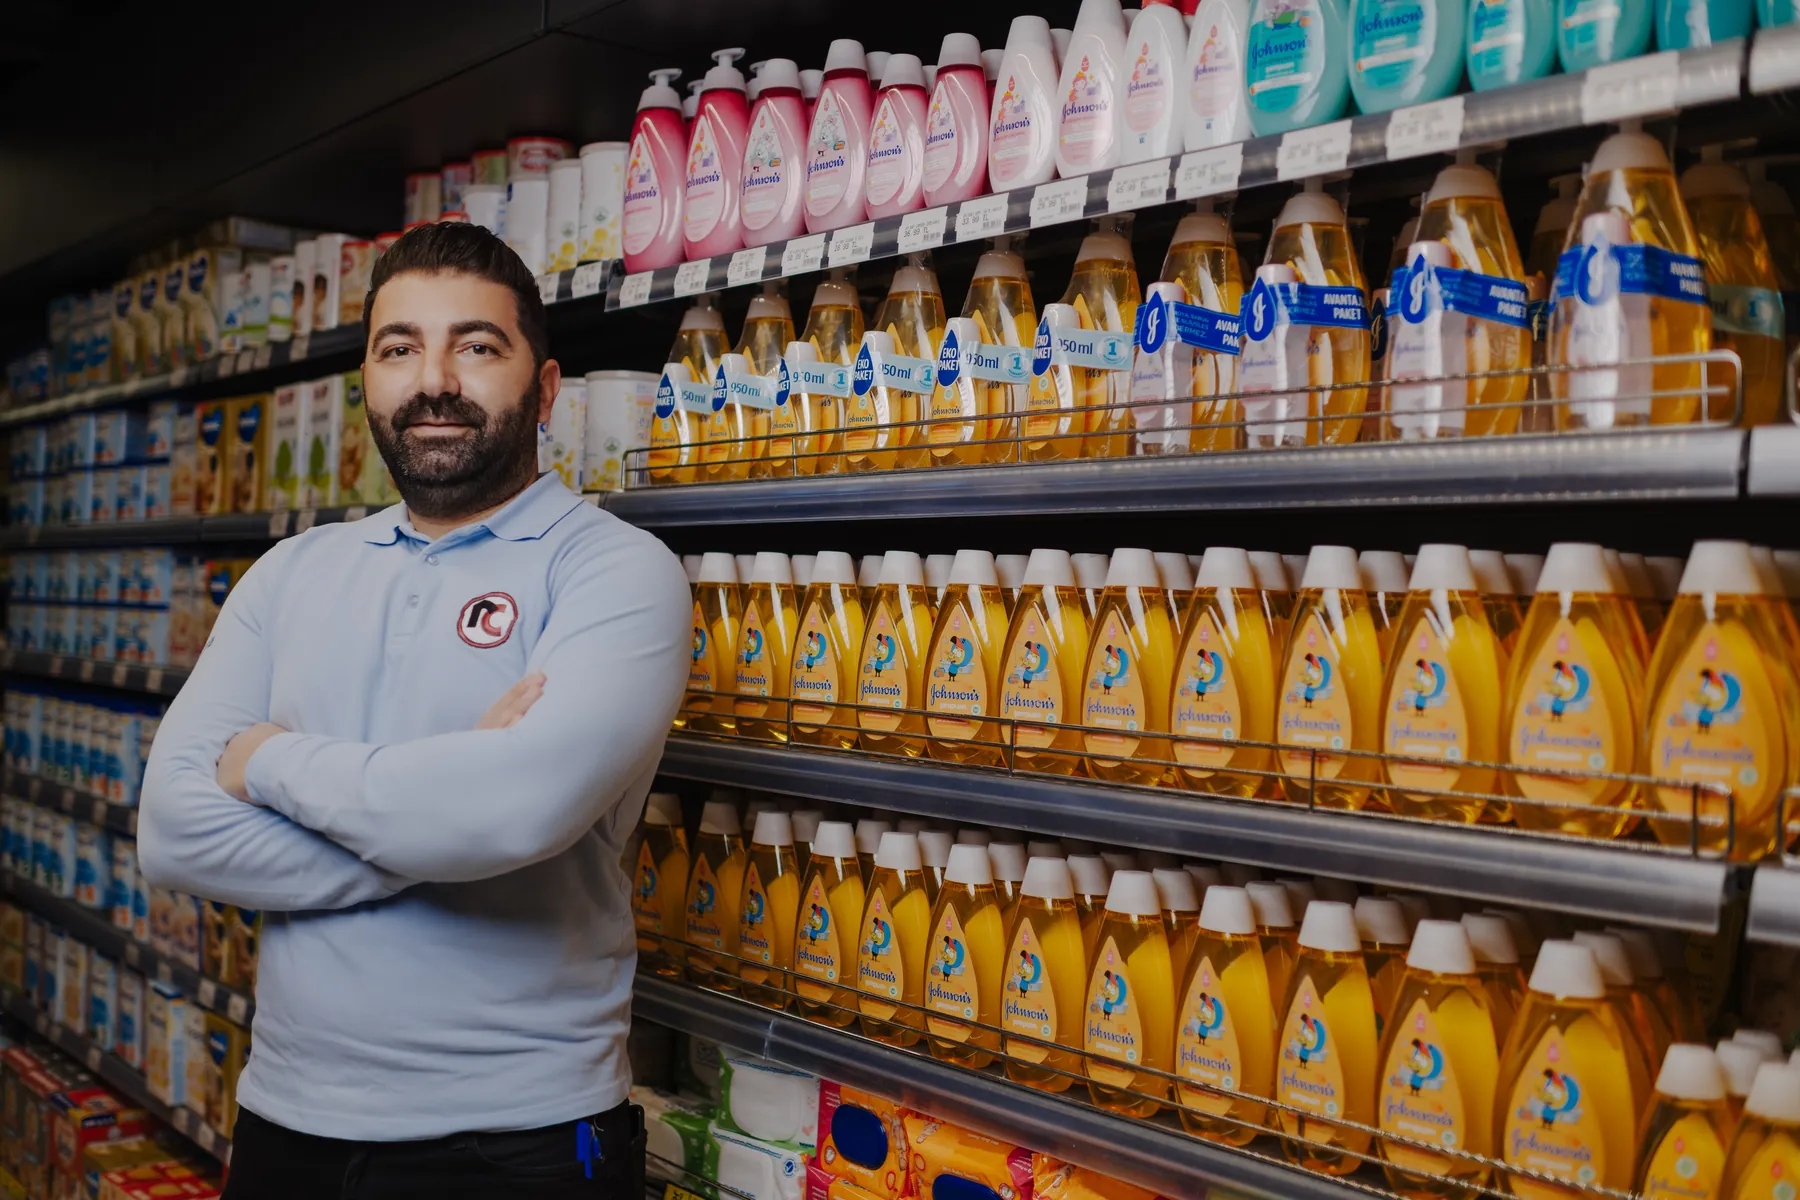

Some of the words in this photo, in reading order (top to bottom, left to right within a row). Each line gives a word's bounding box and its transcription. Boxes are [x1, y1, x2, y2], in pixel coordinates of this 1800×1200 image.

[1333, 308, 1361, 320] PAKET
[1036, 334, 1049, 344] EKO
[857, 359, 869, 369] EKO
[943, 348, 956, 358] EKO
[793, 676, 832, 695] Johnson's
[861, 680, 901, 700] Johnson's
[930, 684, 980, 706] Johnson's
[1004, 690, 1056, 714] Johnson's
[1086, 696, 1136, 721] Johnson's
[1175, 703, 1232, 730] Johnson's
[797, 944, 835, 967] Johnson's
[859, 960, 897, 983] Johnson's
[928, 981, 972, 1004] Johnson's
[1004, 998, 1049, 1022] Johnson's
[1088, 1019, 1135, 1046] Johnson's
[1179, 1043, 1232, 1072] Johnson's
